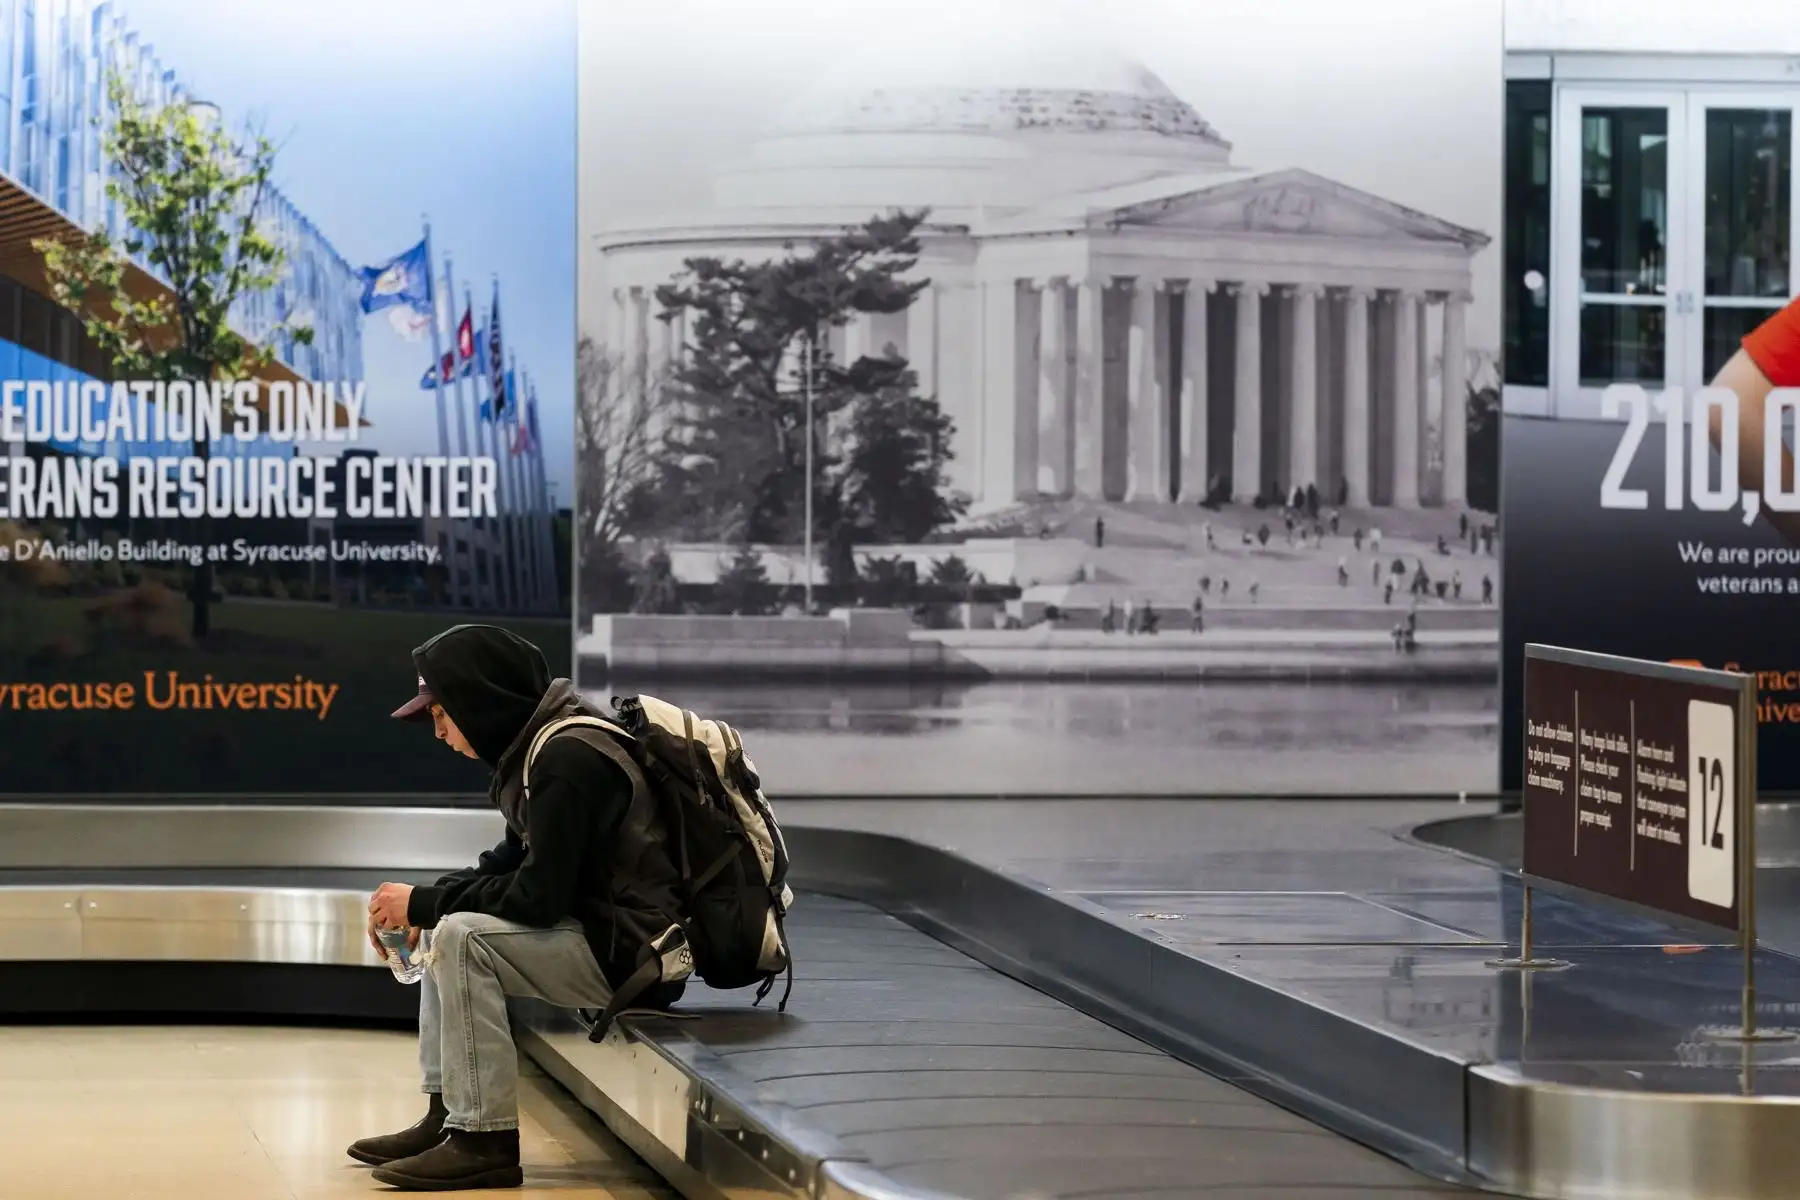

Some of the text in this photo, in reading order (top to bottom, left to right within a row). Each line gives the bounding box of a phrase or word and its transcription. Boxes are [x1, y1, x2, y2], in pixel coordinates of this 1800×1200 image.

[2, 380, 367, 441] EDUCATION'S ONLY
[129, 456, 337, 518] RESOURCE
[346, 456, 497, 518] CENTER
[15, 539, 113, 561] D'Aniello
[118, 539, 203, 566] Building
[207, 543, 228, 561] at
[233, 539, 326, 566] Syracuse
[331, 539, 441, 566] University.
[1678, 541, 1800, 568] We are prou
[1697, 574, 1783, 594] veterans
[144, 671, 338, 720] University
[1698, 756, 1724, 850] 12
